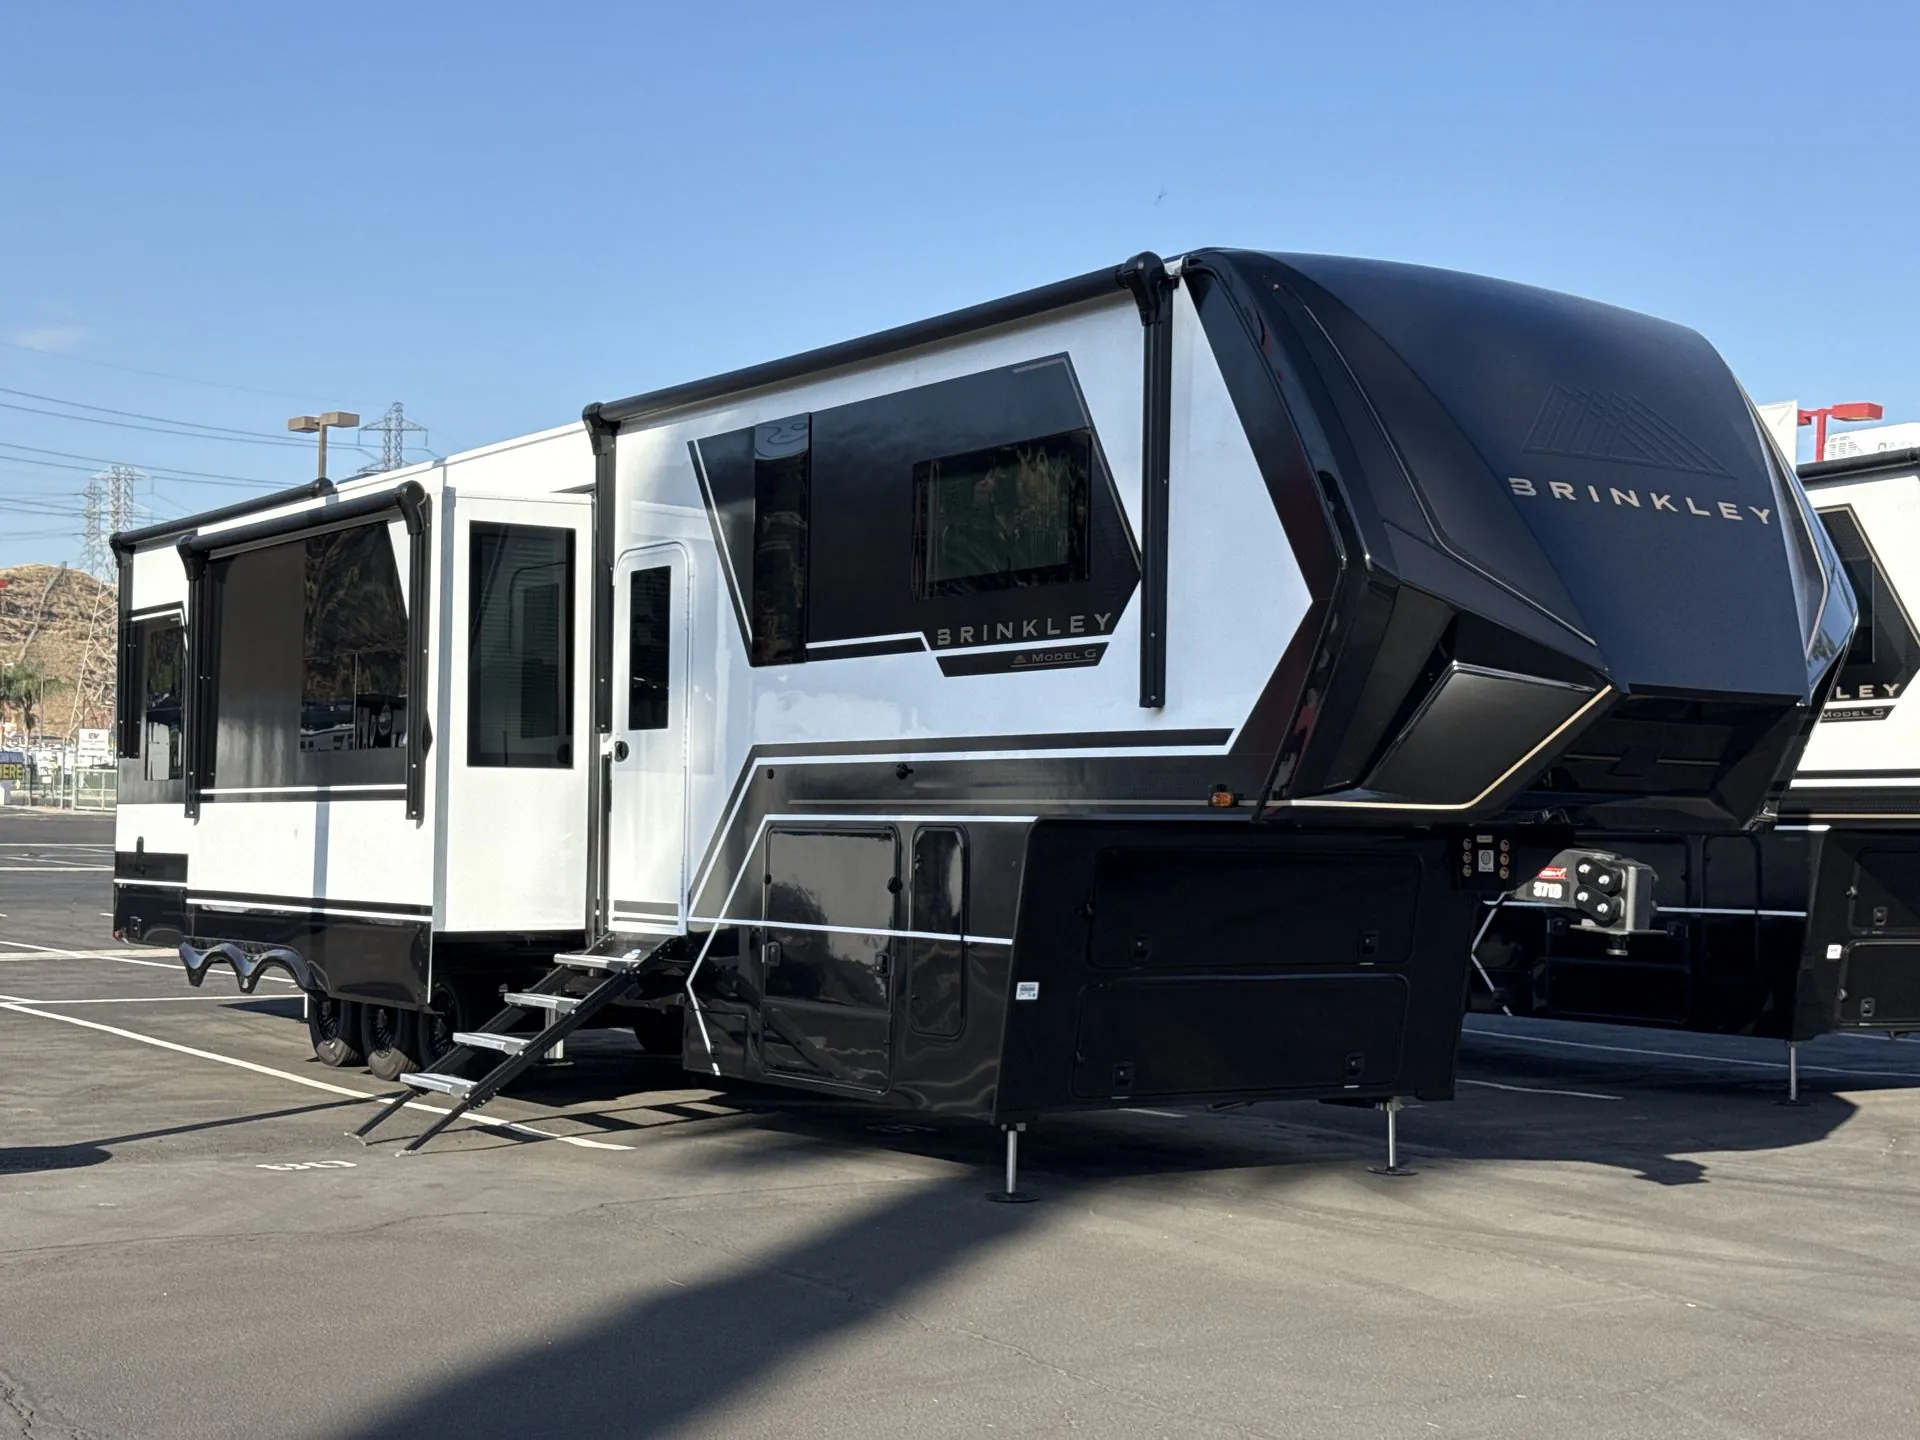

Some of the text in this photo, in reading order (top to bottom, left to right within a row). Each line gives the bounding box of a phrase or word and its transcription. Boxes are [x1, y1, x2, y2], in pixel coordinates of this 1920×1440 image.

[1508, 477, 1770, 525] BRINKLEY
[937, 612, 1112, 646] BRINKLEY
[1083, 648, 1097, 659] G
[1872, 707, 1885, 717] G
